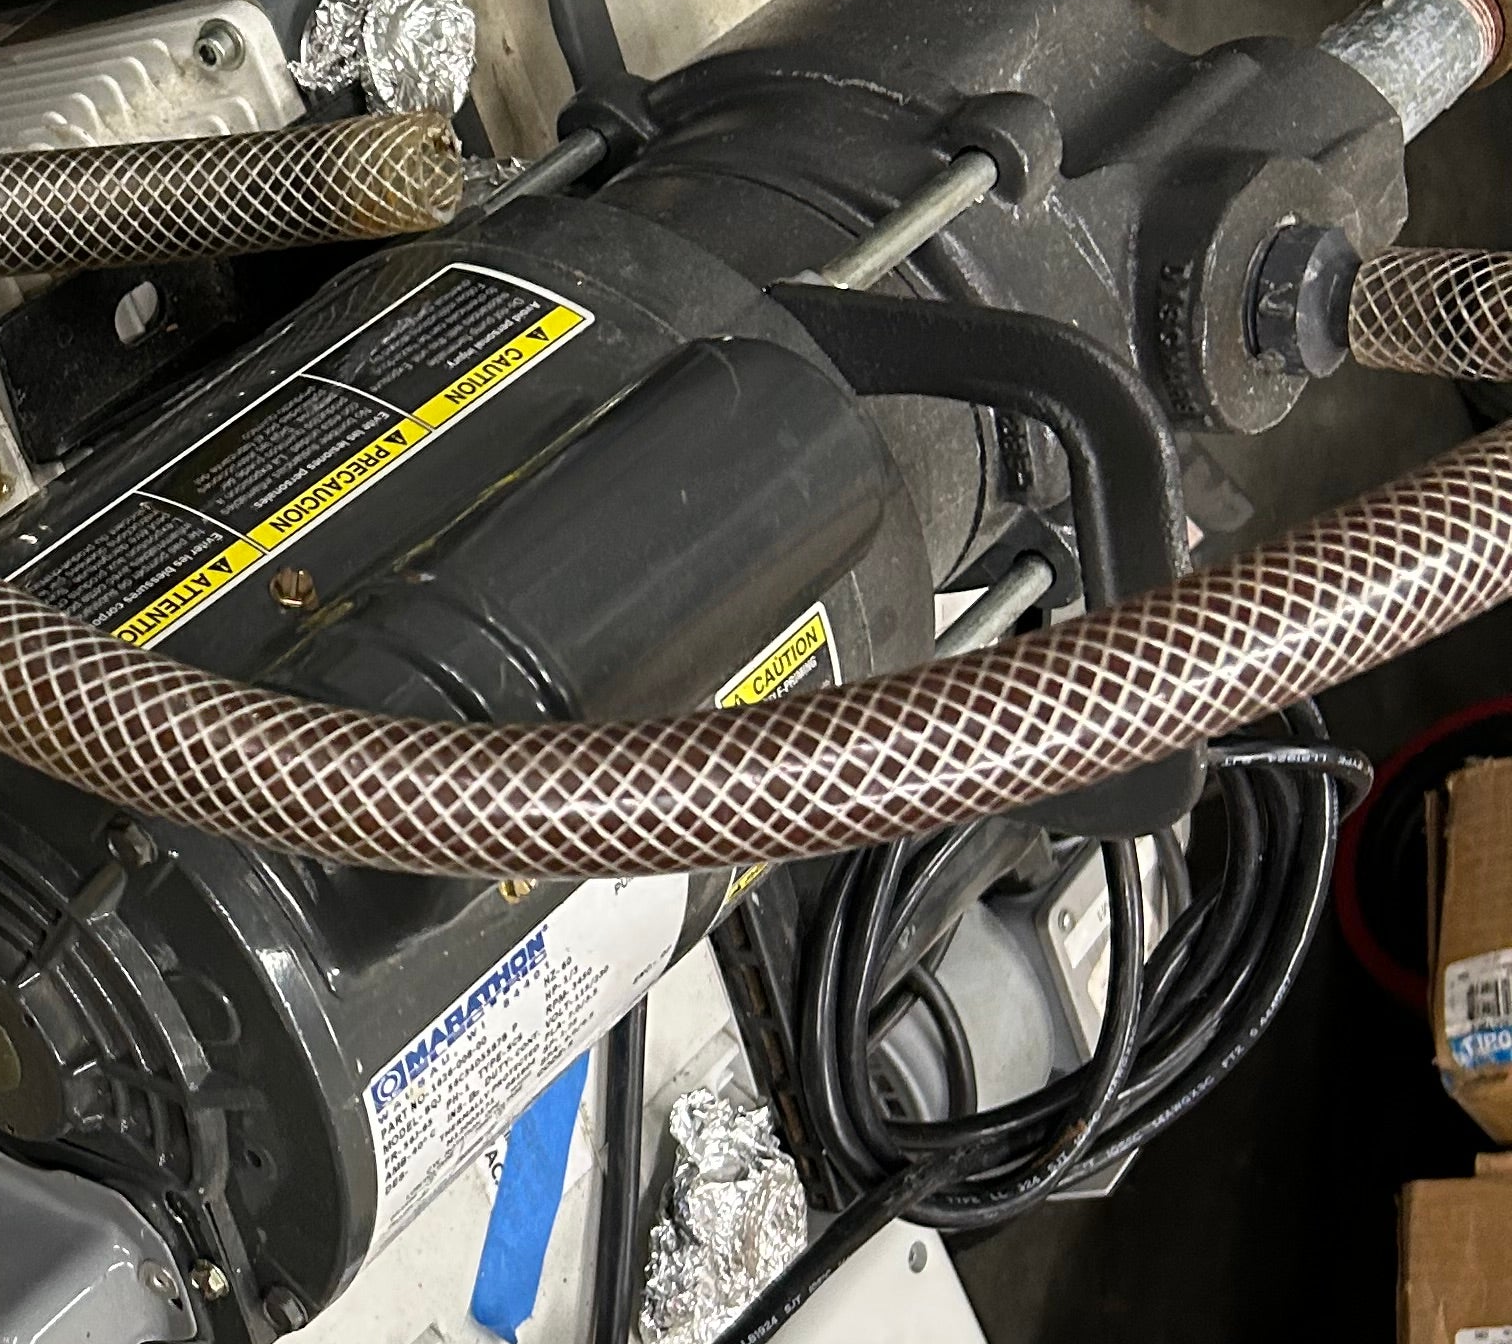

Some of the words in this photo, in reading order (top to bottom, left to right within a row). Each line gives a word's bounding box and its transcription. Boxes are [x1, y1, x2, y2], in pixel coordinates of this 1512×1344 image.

[441, 342, 525, 408] CAUTION
[303, 437, 350, 472] lesiones
[263, 440, 395, 535] PRECAUCION
[120, 563, 177, 606] blessures
[171, 550, 193, 569] les
[86, 599, 125, 630] corpo
[108, 570, 216, 650] ATTENTIO
[745, 625, 824, 696] CAUTION
[406, 930, 546, 1071] MARATHON
[377, 1106, 412, 1140] PART
